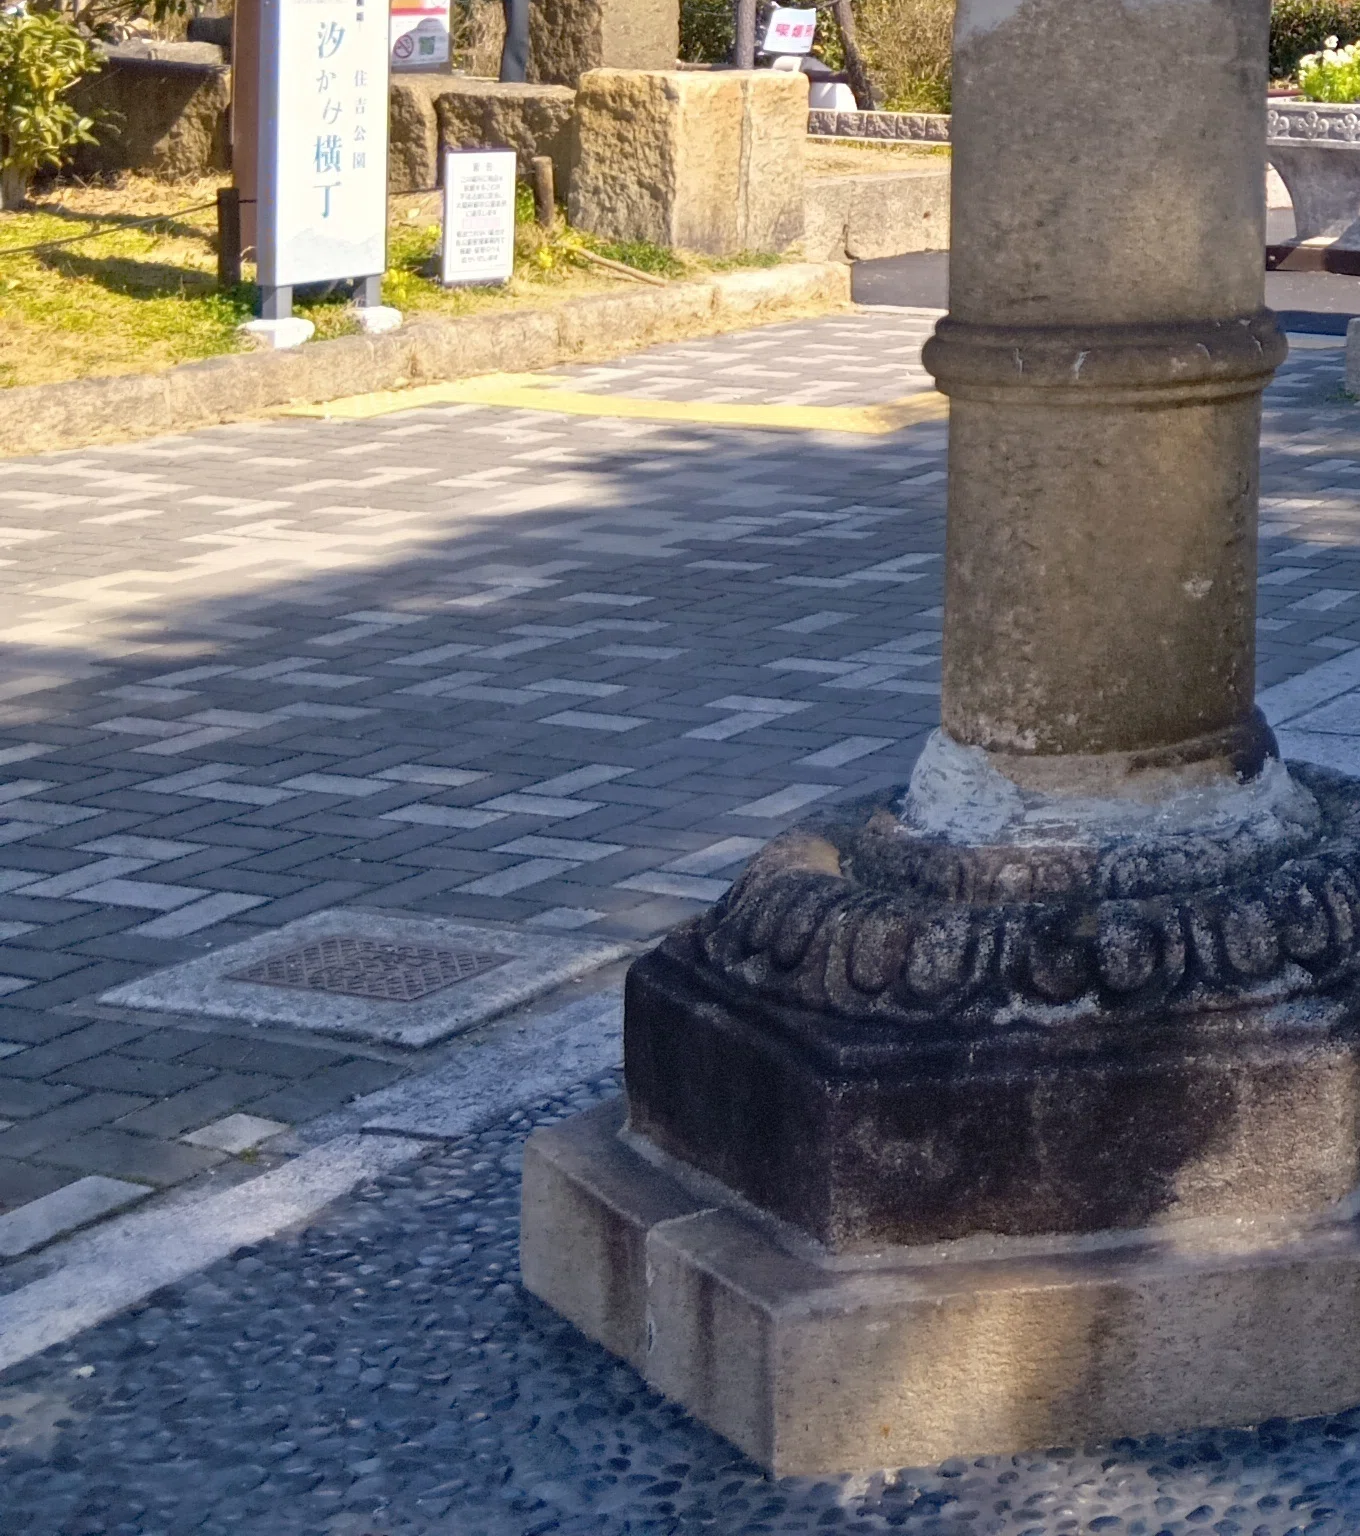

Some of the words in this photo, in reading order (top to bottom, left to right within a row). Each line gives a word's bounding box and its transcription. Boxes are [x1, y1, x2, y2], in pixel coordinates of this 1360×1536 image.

[313, 20, 346, 219] 汐かけ横丁
[352, 69, 368, 170] 住吉公園
